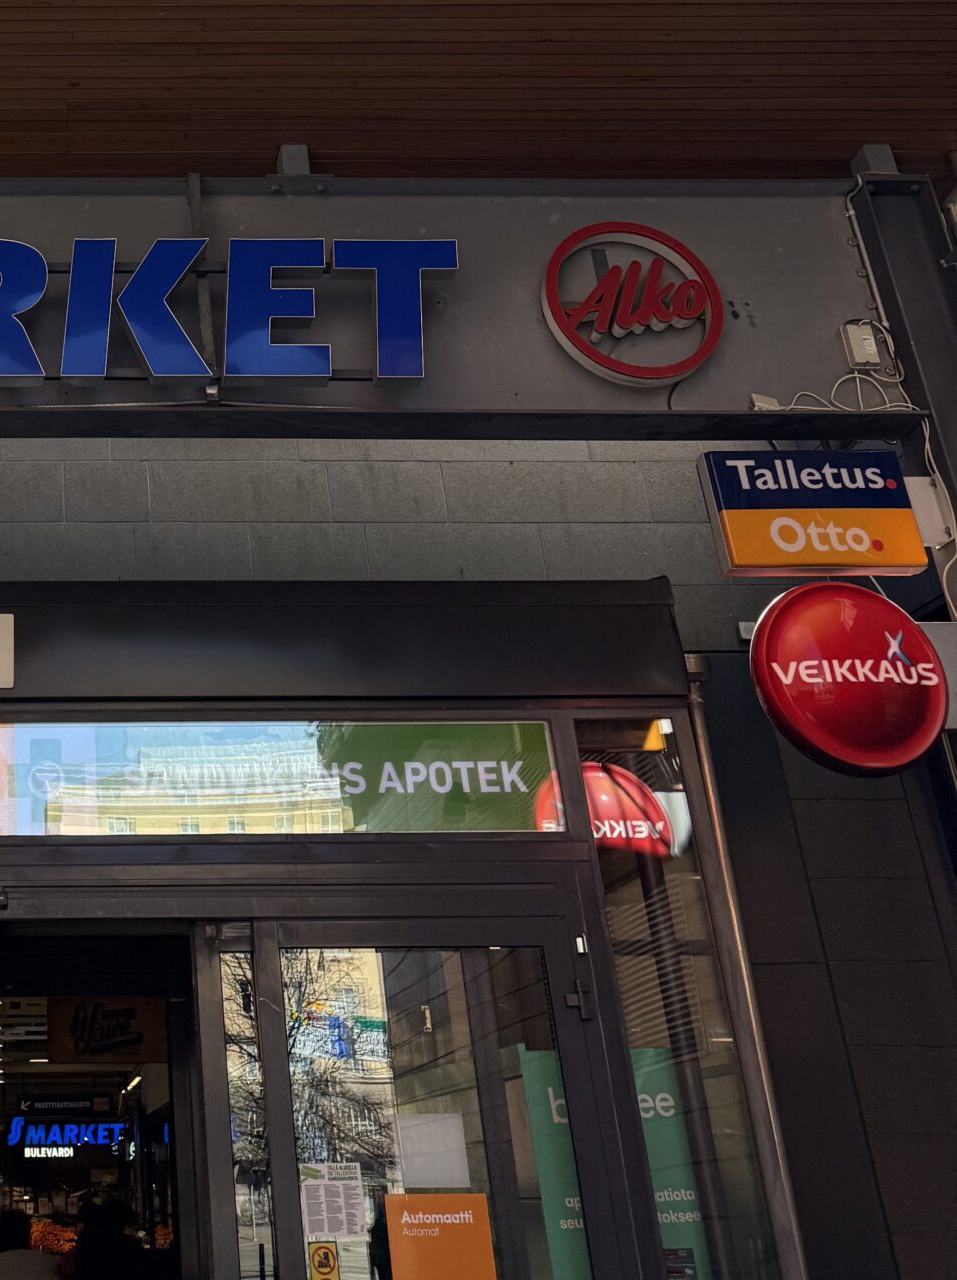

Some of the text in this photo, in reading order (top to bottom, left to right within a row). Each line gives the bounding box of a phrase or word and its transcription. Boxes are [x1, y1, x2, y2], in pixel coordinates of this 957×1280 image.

[563, 256, 708, 334] Alko
[770, 658, 939, 686] VEIKKAUS
[378, 760, 529, 794] APOTEK
[24, 1123, 125, 1146] MARKET
[24, 1147, 74, 1158] BULEVARDI
[401, 1210, 474, 1224] Automaatti
[402, 1226, 439, 1236] Automat
